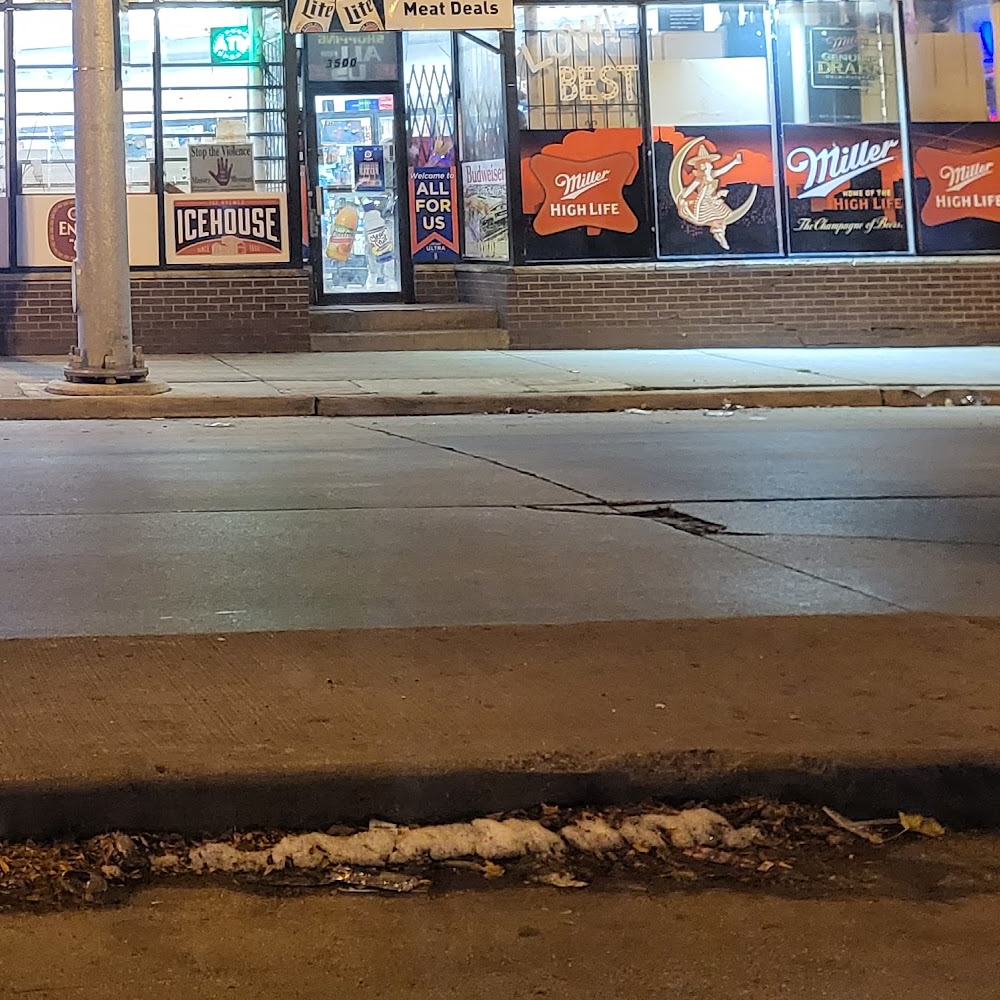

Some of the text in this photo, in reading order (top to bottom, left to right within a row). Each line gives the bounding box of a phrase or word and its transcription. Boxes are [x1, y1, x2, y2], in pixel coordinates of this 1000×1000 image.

[404, 1, 499, 16] Meat Deals
[558, 64, 639, 101] BEST
[191, 145, 251, 160] Stop the Violence
[411, 172, 445, 180] Welcome
[466, 165, 505, 184] Budweiser
[786, 139, 899, 199] Miller
[939, 162, 994, 192] Miller
[416, 181, 450, 196] ALL
[555, 170, 611, 200] Miller
[415, 199, 451, 213] FOR
[834, 198, 903, 210] HIGH LIFE
[935, 195, 1000, 208] HIGH LIFE
[550, 202, 620, 217] HIGH LIFE
[176, 207, 278, 244] ICEHOUSE
[422, 216, 446, 230] US
[793, 217, 815, 231] The
[814, 217, 864, 235] Champagne
[865, 217, 876, 235] of
